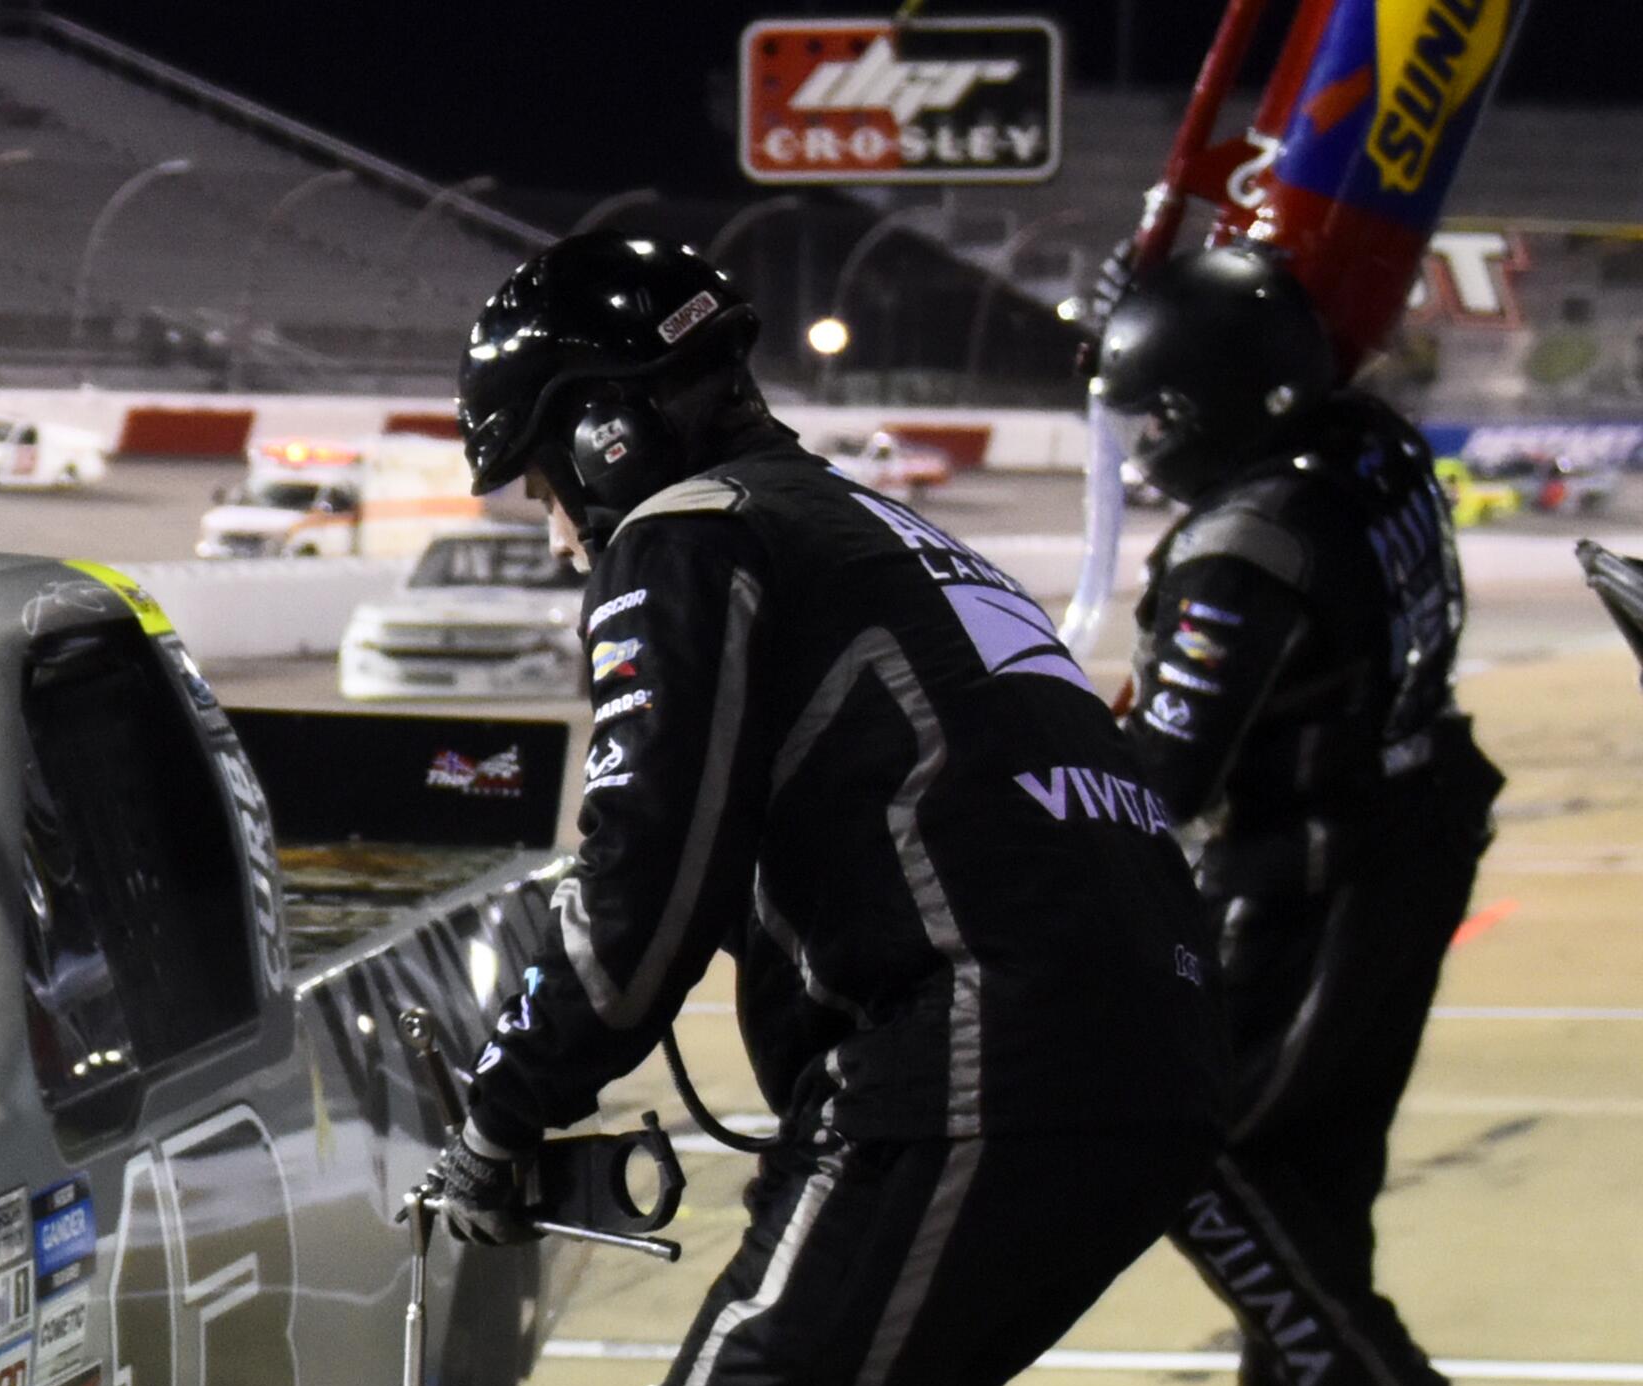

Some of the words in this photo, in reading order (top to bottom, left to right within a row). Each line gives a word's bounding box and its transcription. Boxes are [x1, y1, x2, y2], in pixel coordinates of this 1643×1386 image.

[762, 126, 1041, 164] CROSLEY
[662, 294, 716, 341] SIMPSON
[1012, 765, 1170, 836] VIVITA
